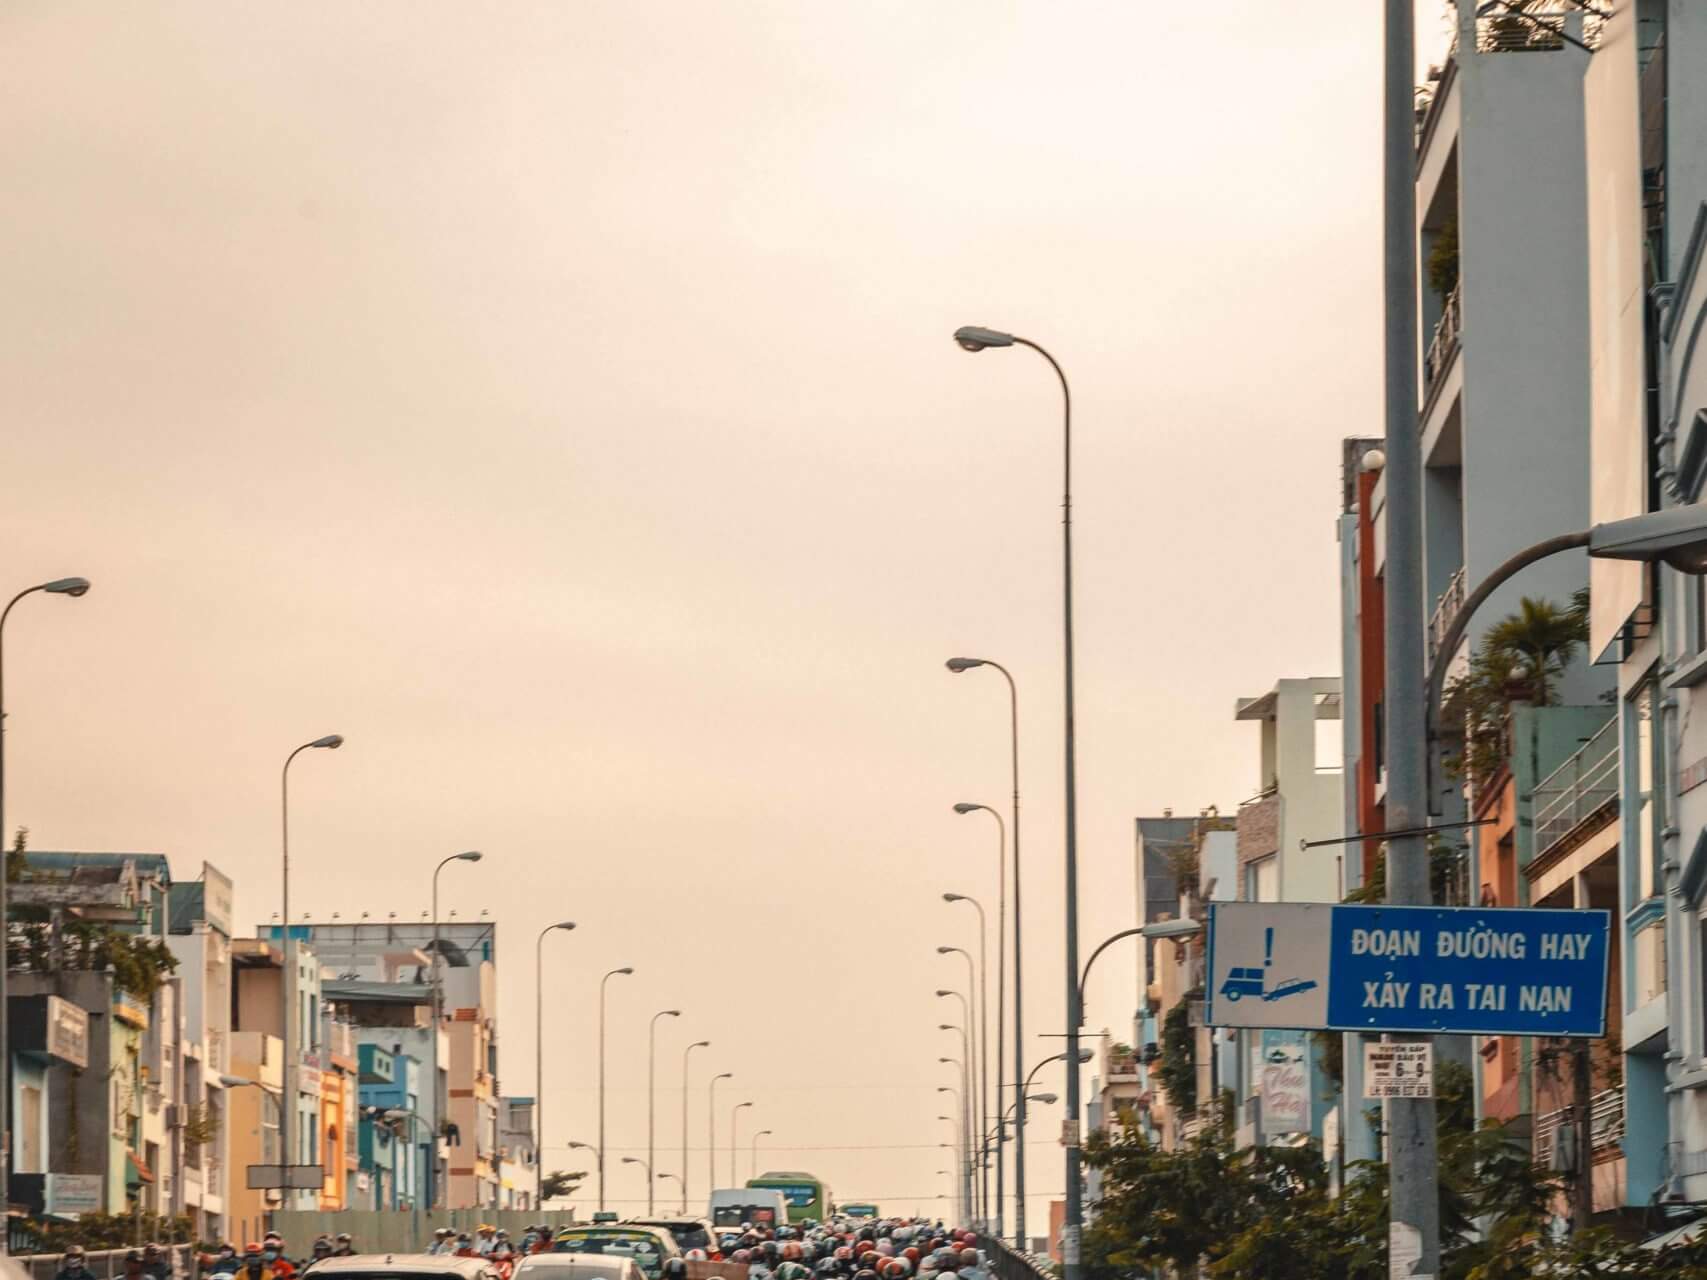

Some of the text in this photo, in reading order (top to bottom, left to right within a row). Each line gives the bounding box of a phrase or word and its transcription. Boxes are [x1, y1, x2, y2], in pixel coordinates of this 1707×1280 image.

[1351, 920, 1592, 960] ĐOẠN ĐƯỜNG HAY
[1362, 971, 1572, 1016] XẢY RA TAI NẠN
